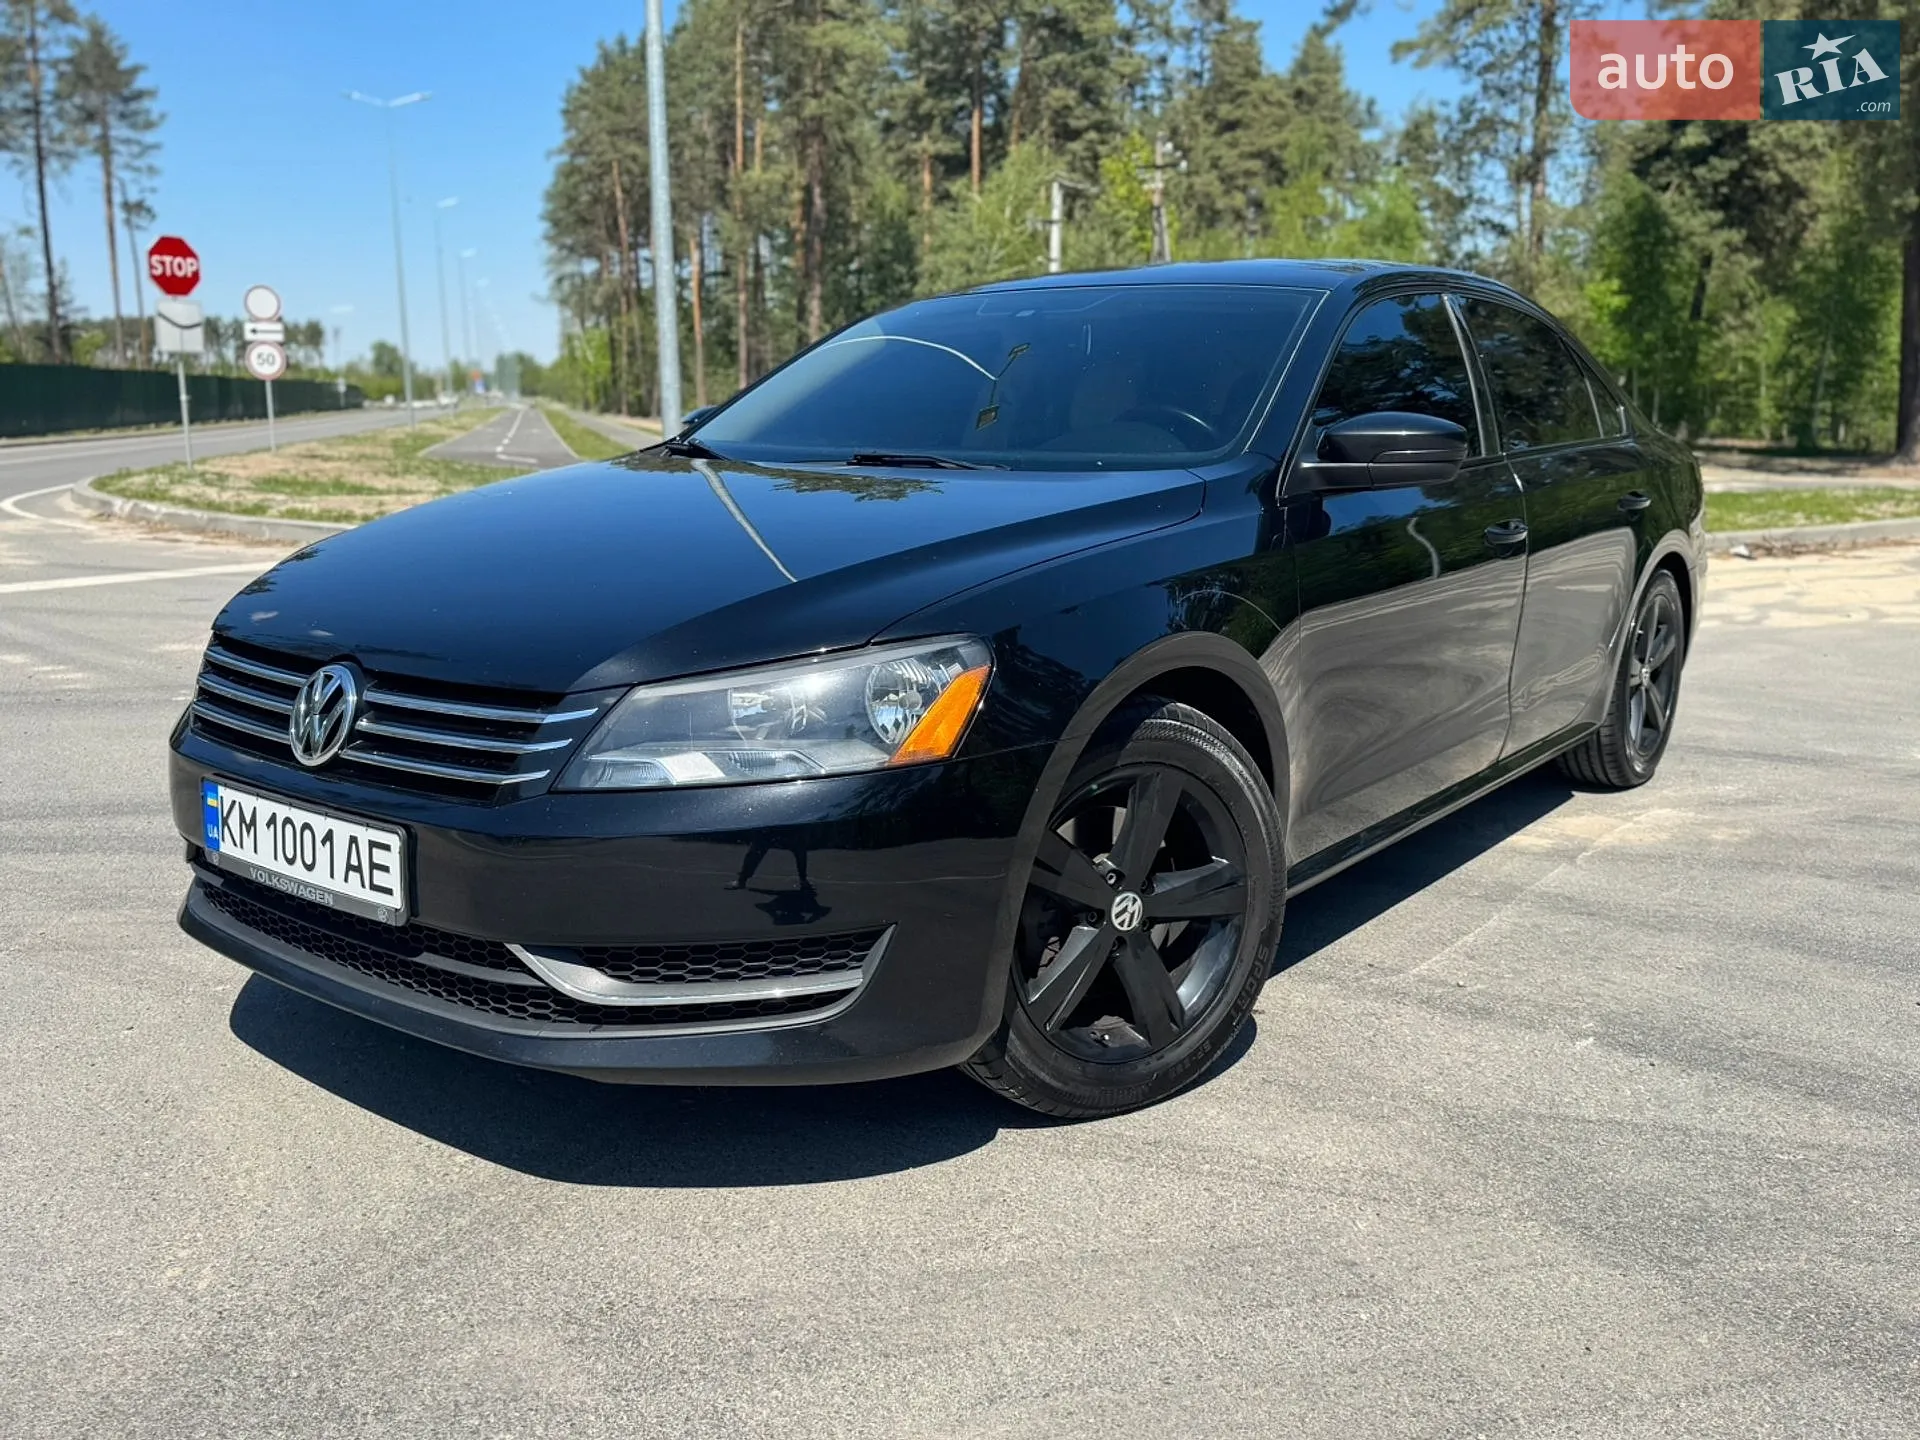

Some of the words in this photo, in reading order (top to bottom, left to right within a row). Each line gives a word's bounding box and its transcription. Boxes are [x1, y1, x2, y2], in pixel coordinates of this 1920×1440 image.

[150, 254, 198, 278] STOP
[256, 351, 276, 366] 50
[208, 826, 219, 840] UA
[249, 867, 335, 906] VOLKSWAGEN
